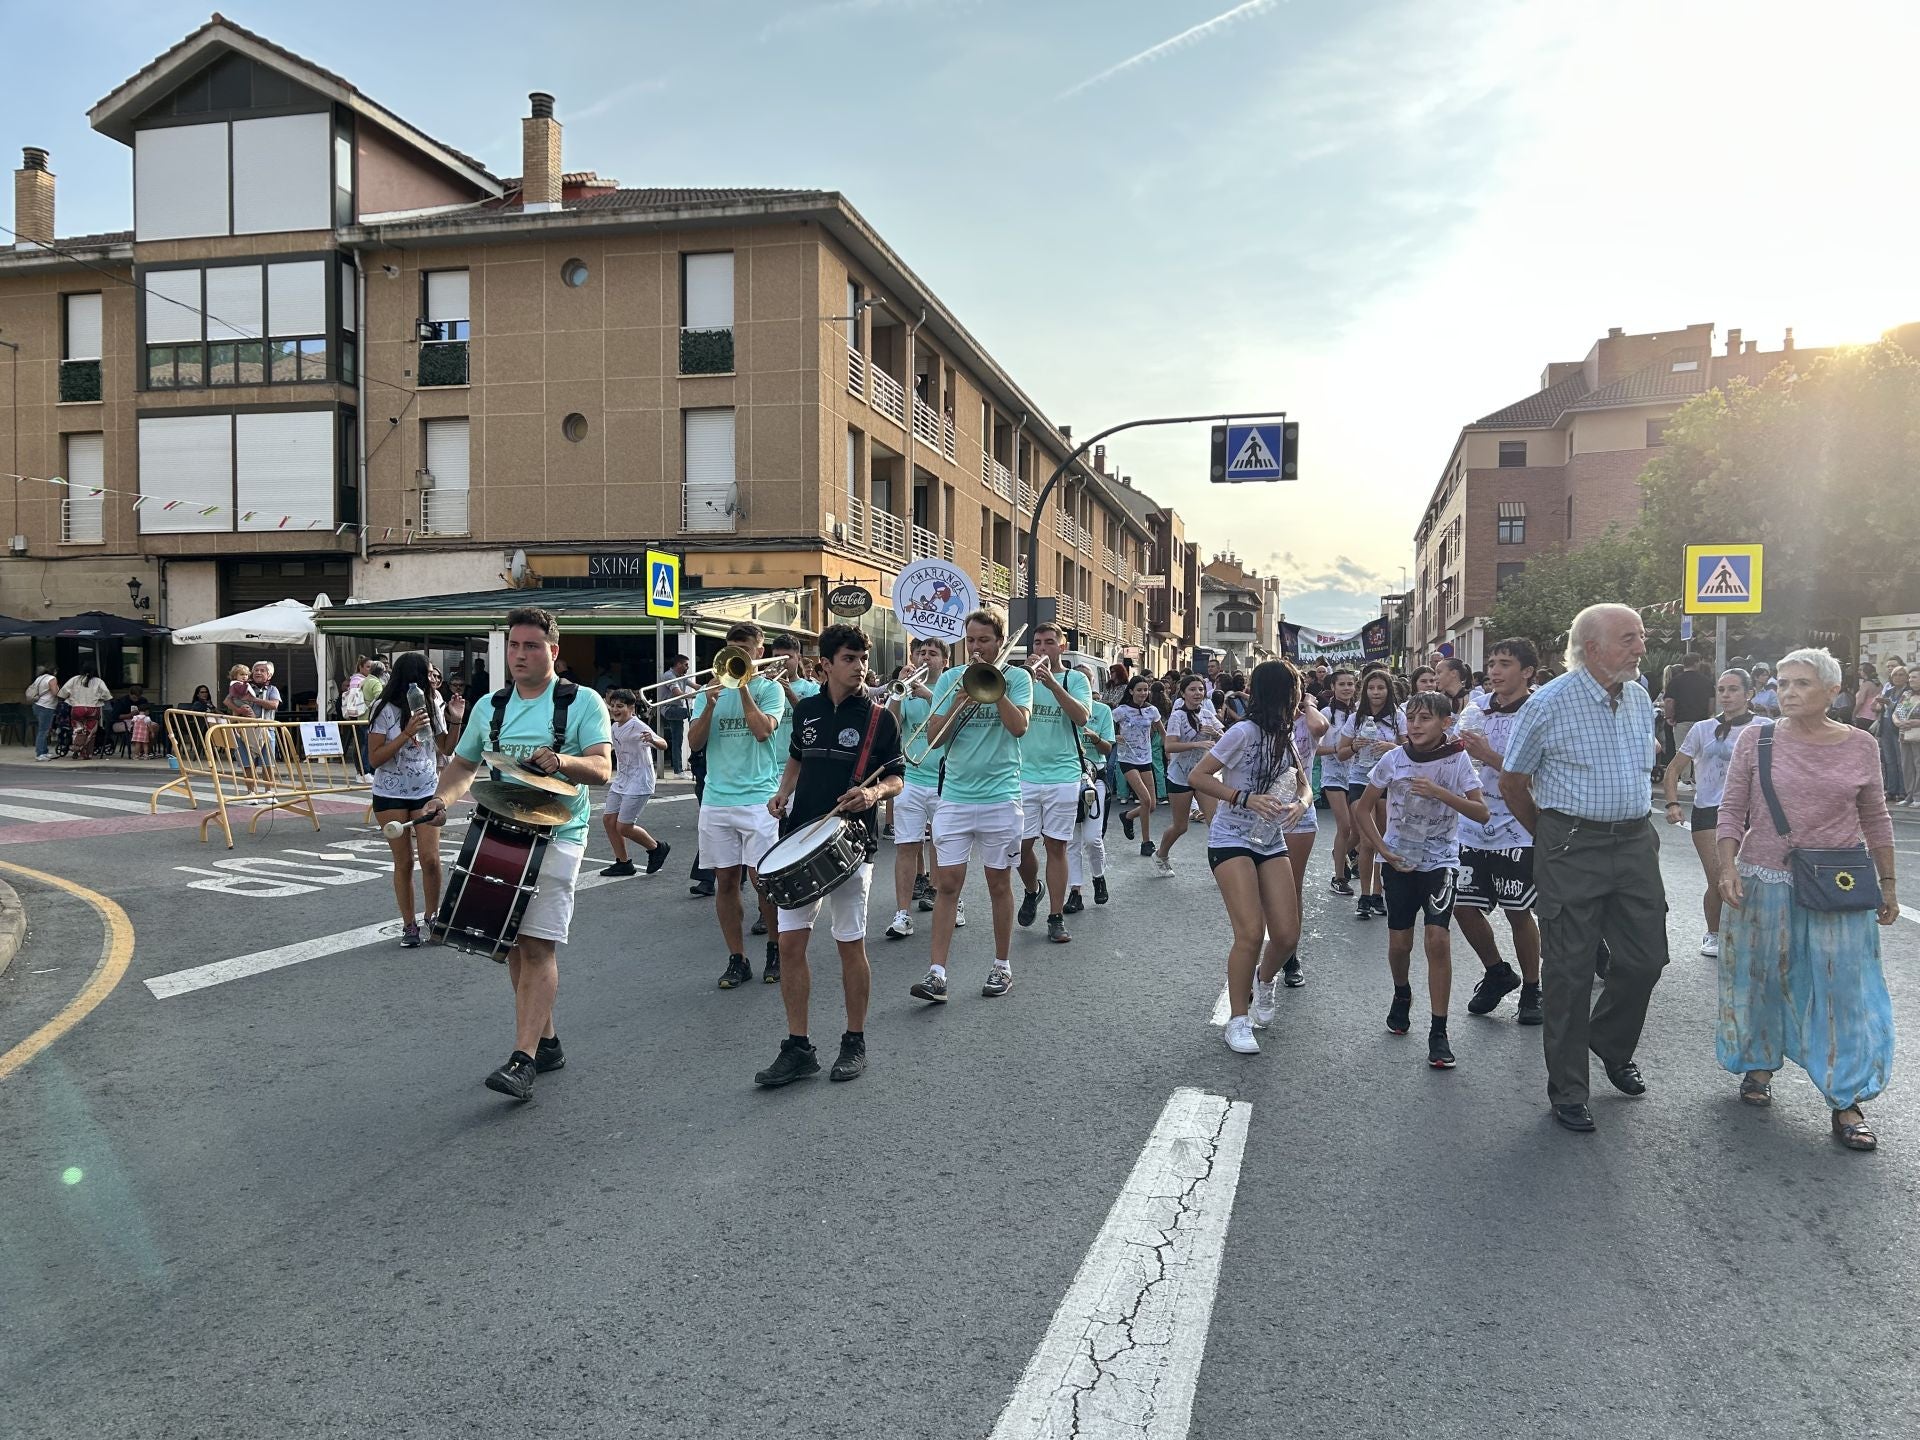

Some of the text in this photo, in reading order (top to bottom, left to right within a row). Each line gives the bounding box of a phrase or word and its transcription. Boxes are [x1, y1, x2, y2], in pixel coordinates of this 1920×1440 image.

[590, 557, 639, 574] SKINA
[910, 568, 965, 595] CHARANGA
[911, 610, 957, 631] ASCAPE
[1300, 643, 1313, 654] LA
